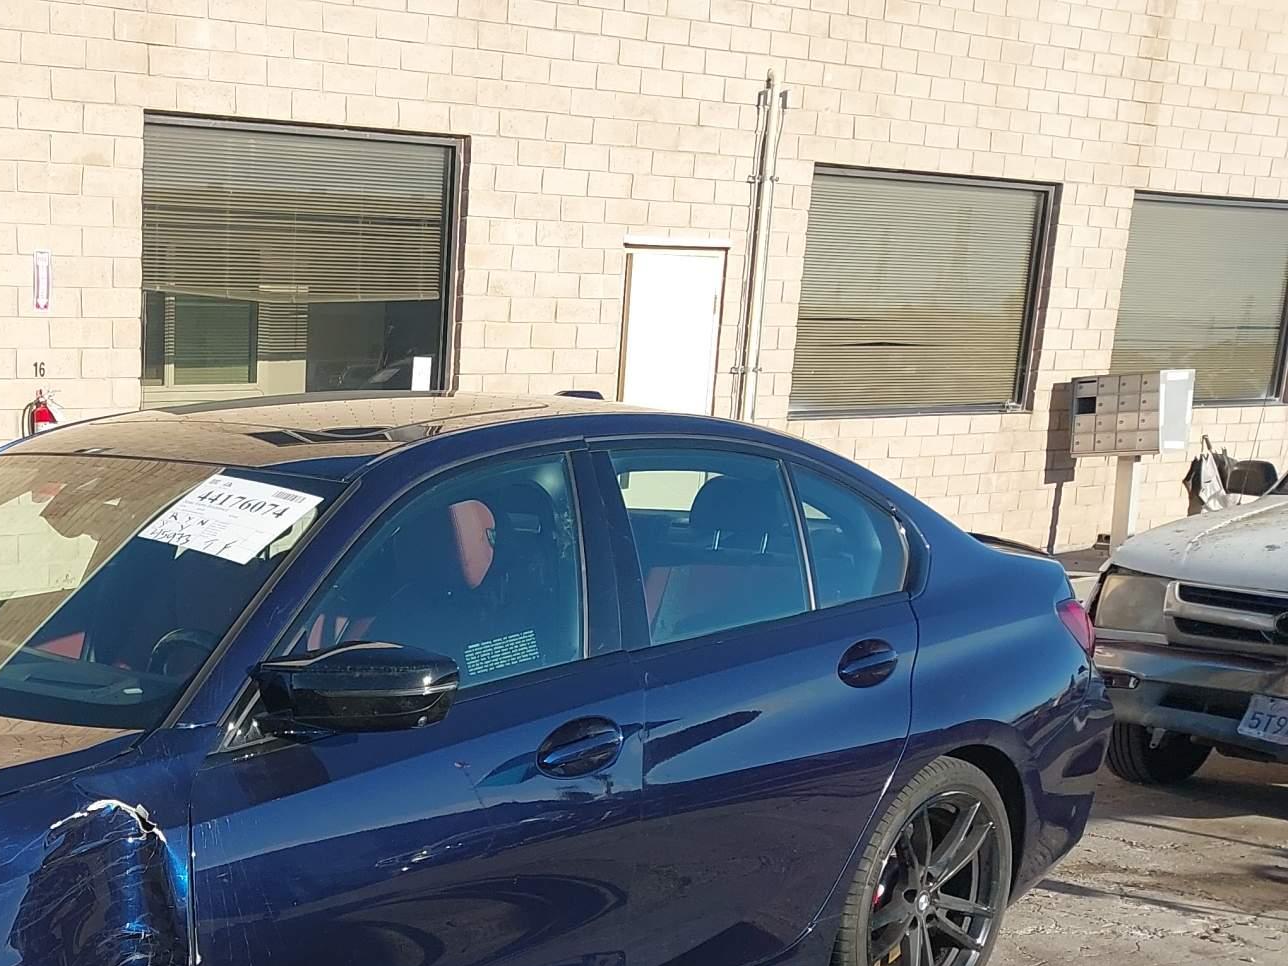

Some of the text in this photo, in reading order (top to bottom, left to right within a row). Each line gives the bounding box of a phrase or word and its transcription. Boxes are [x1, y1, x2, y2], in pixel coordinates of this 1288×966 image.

[33, 361, 45, 377] 16
[197, 490, 290, 518] 44176074
[1248, 711, 1288, 734] 5T9
